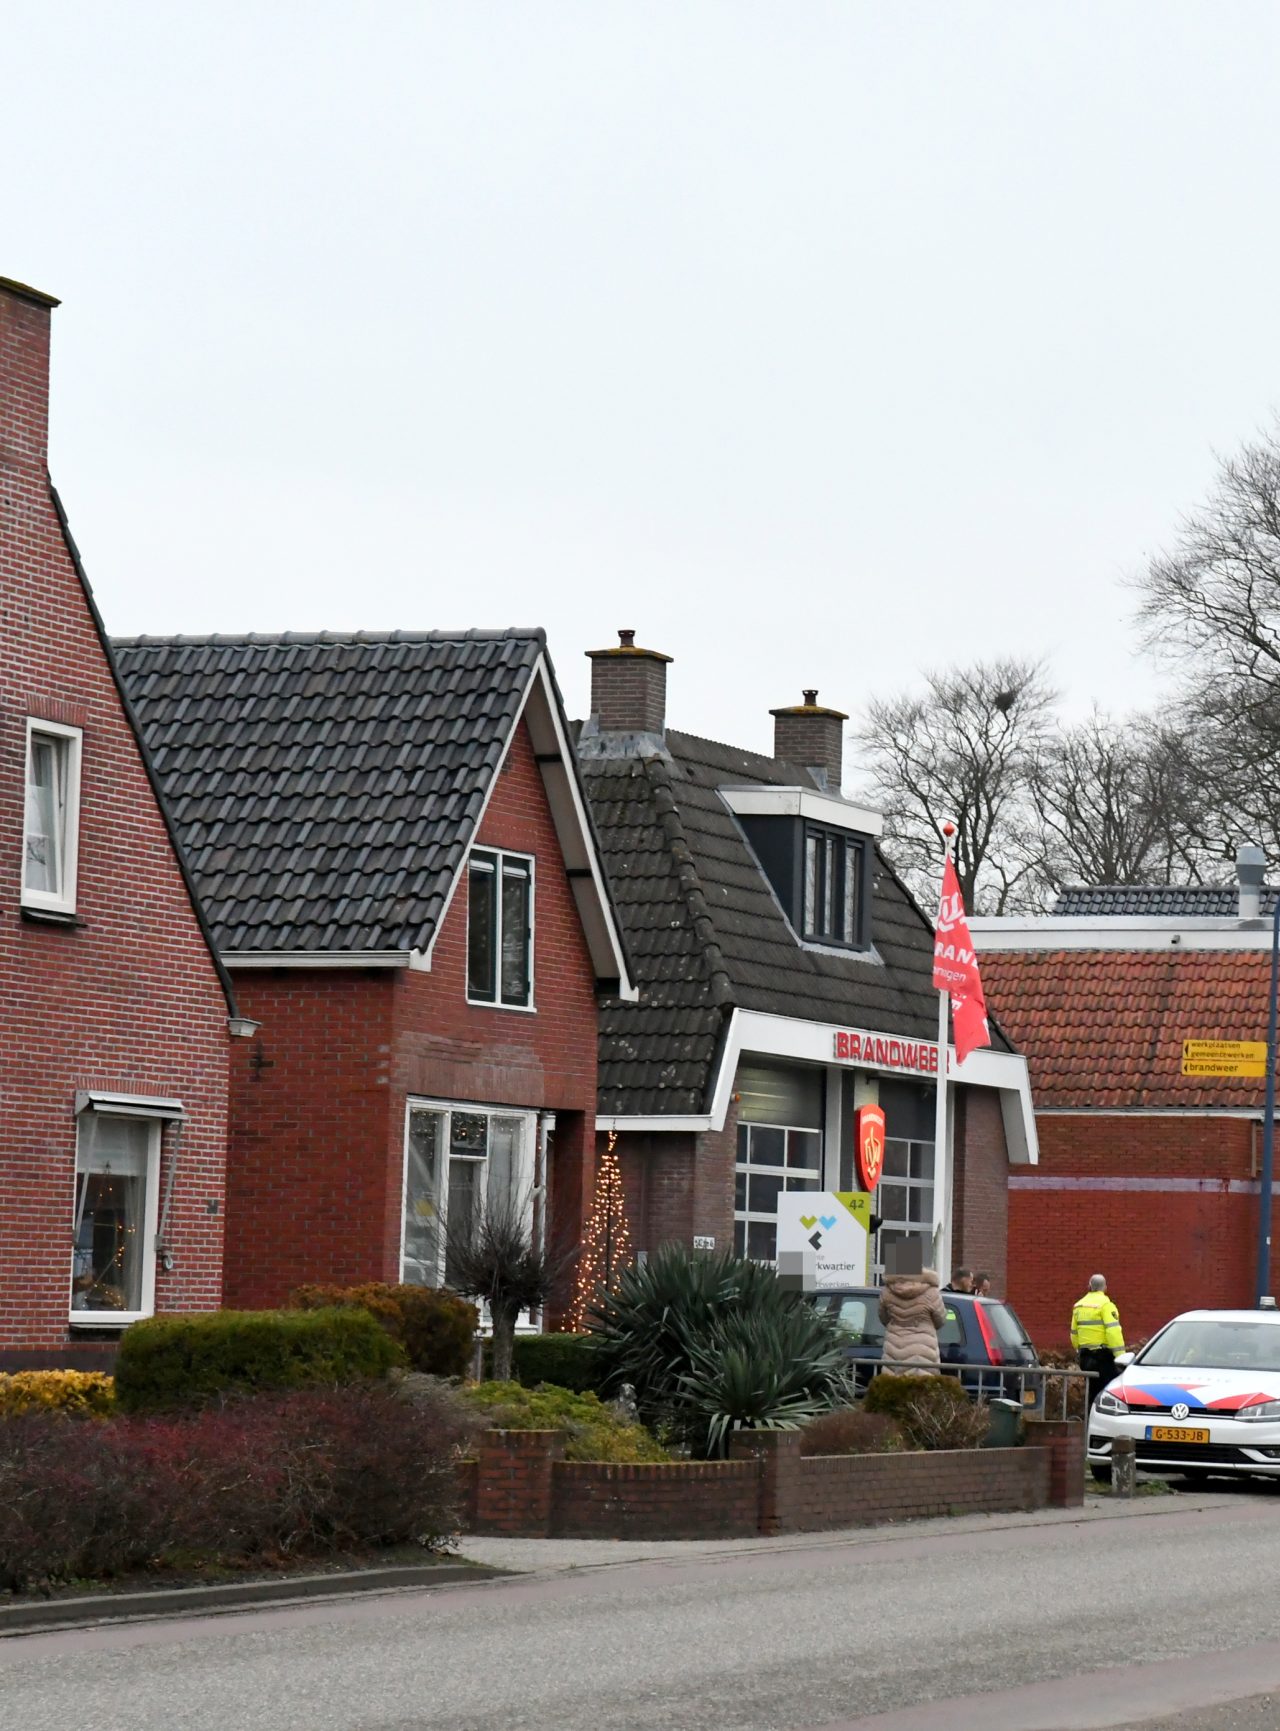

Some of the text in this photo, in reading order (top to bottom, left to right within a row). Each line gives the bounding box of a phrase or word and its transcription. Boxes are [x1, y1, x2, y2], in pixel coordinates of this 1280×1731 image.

[836, 1031, 950, 1074] BRANDWEE
[1189, 1063, 1239, 1073] brandweer
[849, 1199, 865, 1210] 42
[1155, 1429, 1204, 1441] G-533-JB
